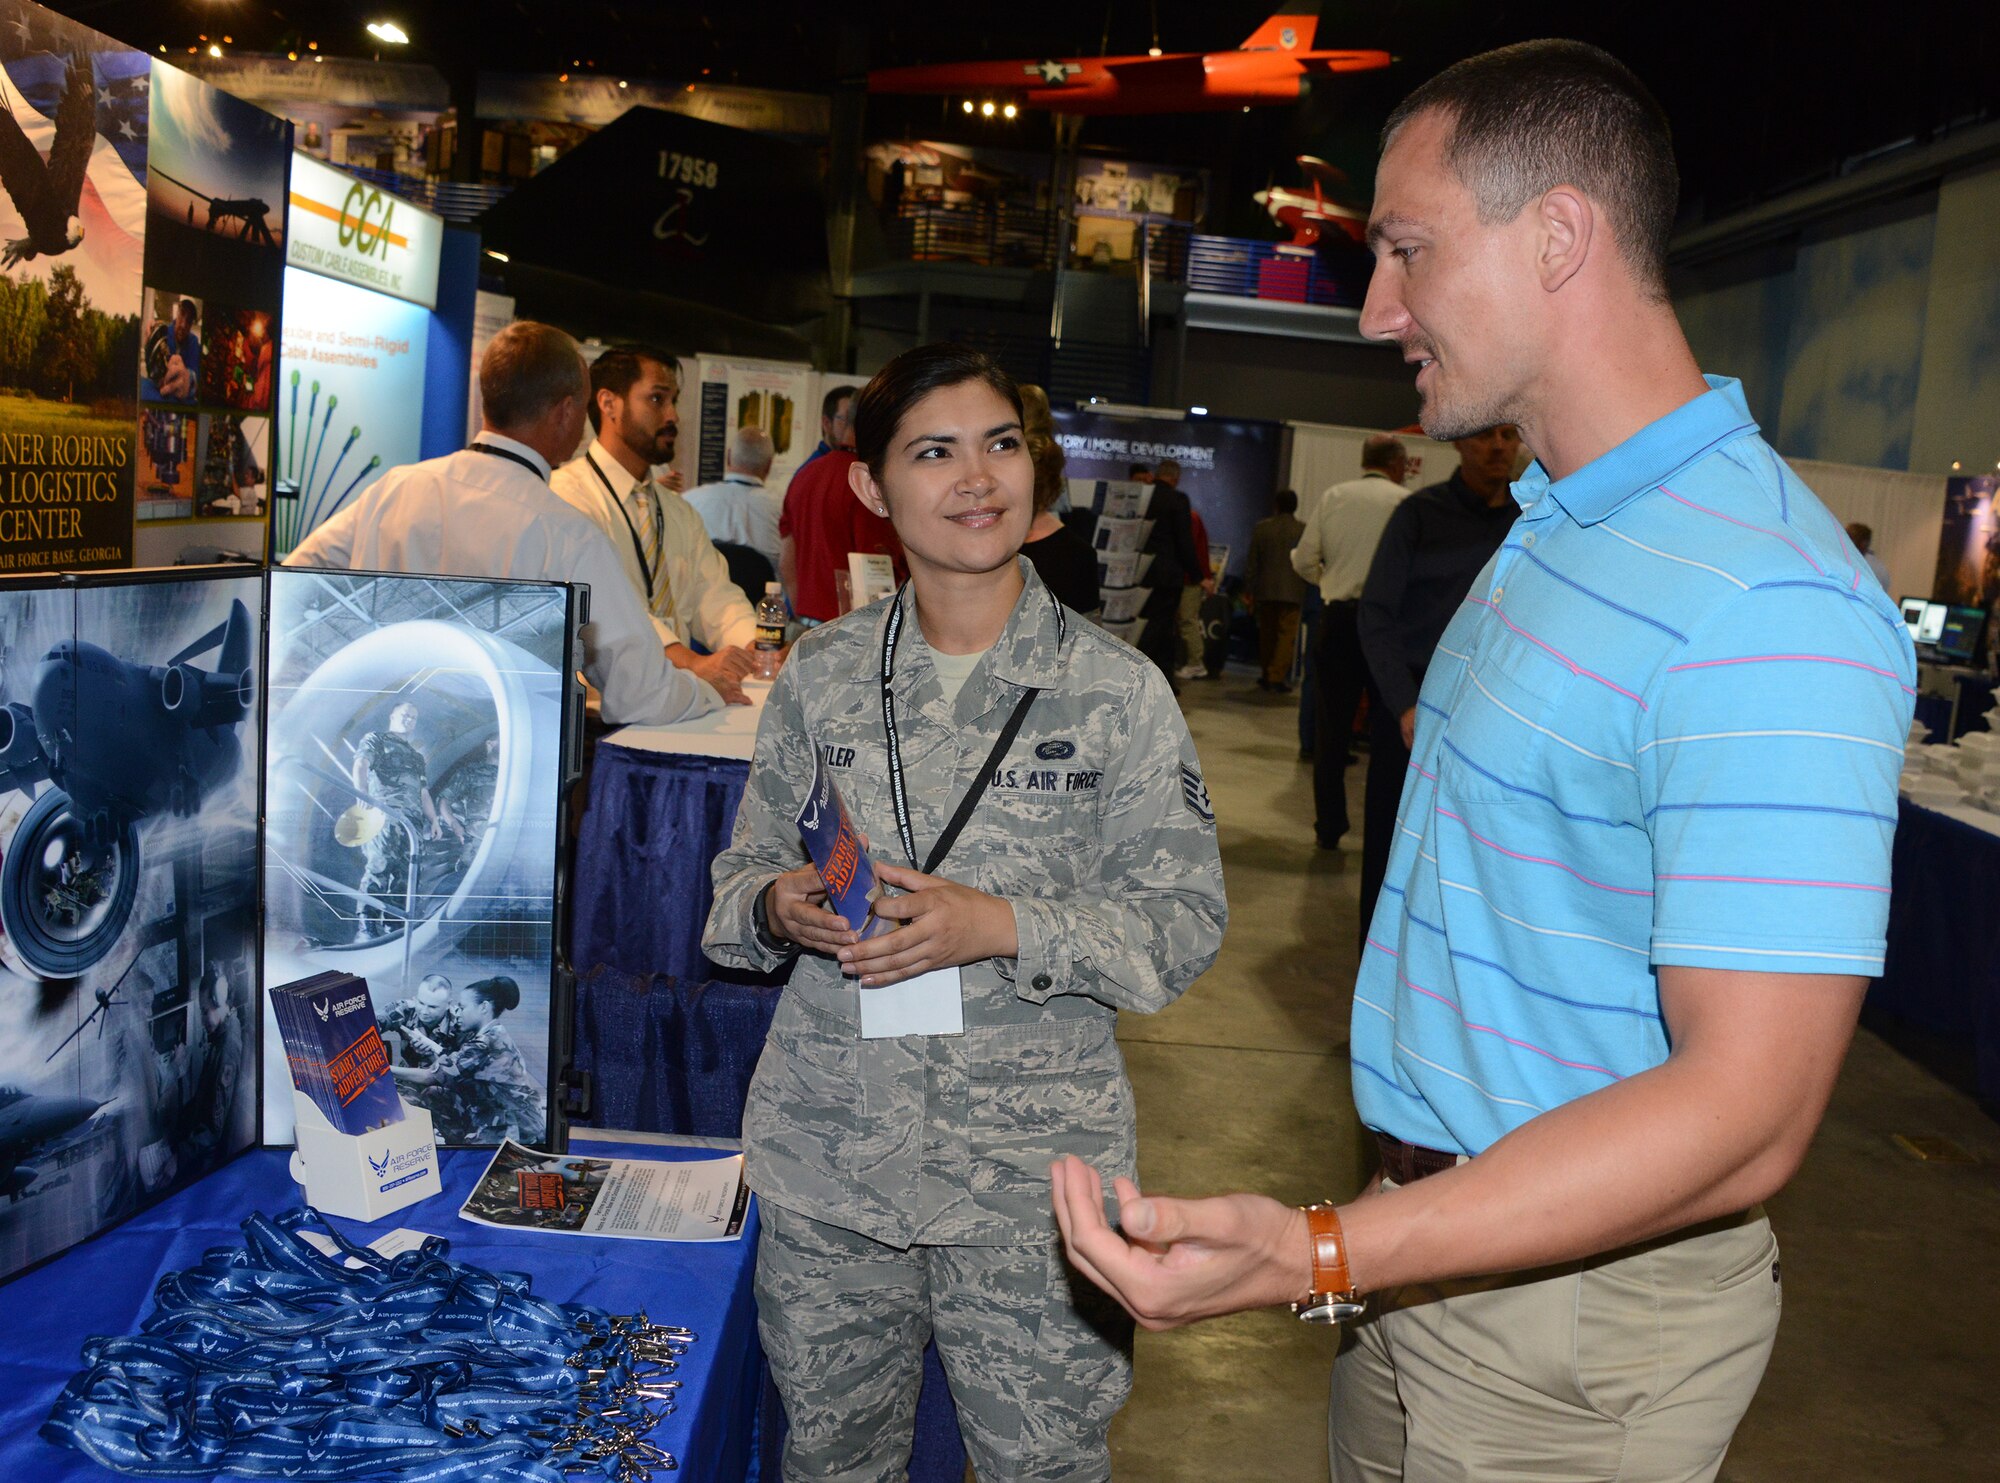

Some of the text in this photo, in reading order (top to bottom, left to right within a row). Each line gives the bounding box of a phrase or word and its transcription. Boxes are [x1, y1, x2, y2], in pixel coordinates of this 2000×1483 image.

[659, 150, 718, 189] 17958
[338, 180, 395, 262] CCA
[291, 239, 324, 266] CUSTOM
[324, 250, 349, 274] CABLE
[339, 331, 410, 357] Semi-Rigid
[310, 347, 378, 369] Assemblies
[51, 434, 127, 467] ROBINS
[1093, 438, 1128, 454] MORE
[1130, 441, 1214, 461] DEVELOPMENT
[10, 471, 118, 504] LOGISTICS
[0, 508, 84, 543] CENTER
[18, 551, 50, 567] FORCE
[80, 546, 122, 562] GEORGIA
[885, 646, 893, 676] MERCER
[885, 697, 915, 861] MERCER ENGINEERING RESEARCH CENTER
[991, 770, 1104, 791] U.S. AIR FORCE
[332, 994, 367, 1012] AIR FORCE
[335, 1001, 366, 1018] RESERVE
[329, 1035, 379, 1084] START YOUR
[338, 1049, 385, 1099] ADVENTURE
[390, 1143, 432, 1166] AIR FORCE
[393, 1152, 431, 1173] RESERVE
[283, 1246, 307, 1268] RESERVE
[357, 1389, 382, 1398] FORCE
[338, 1434, 364, 1442] FORCE
[248, 1452, 302, 1460] AFReserve.com
[346, 1459, 382, 1471] RESERVE
[479, 1453, 504, 1465] FORCE
[440, 1459, 477, 1476] RESERVE
